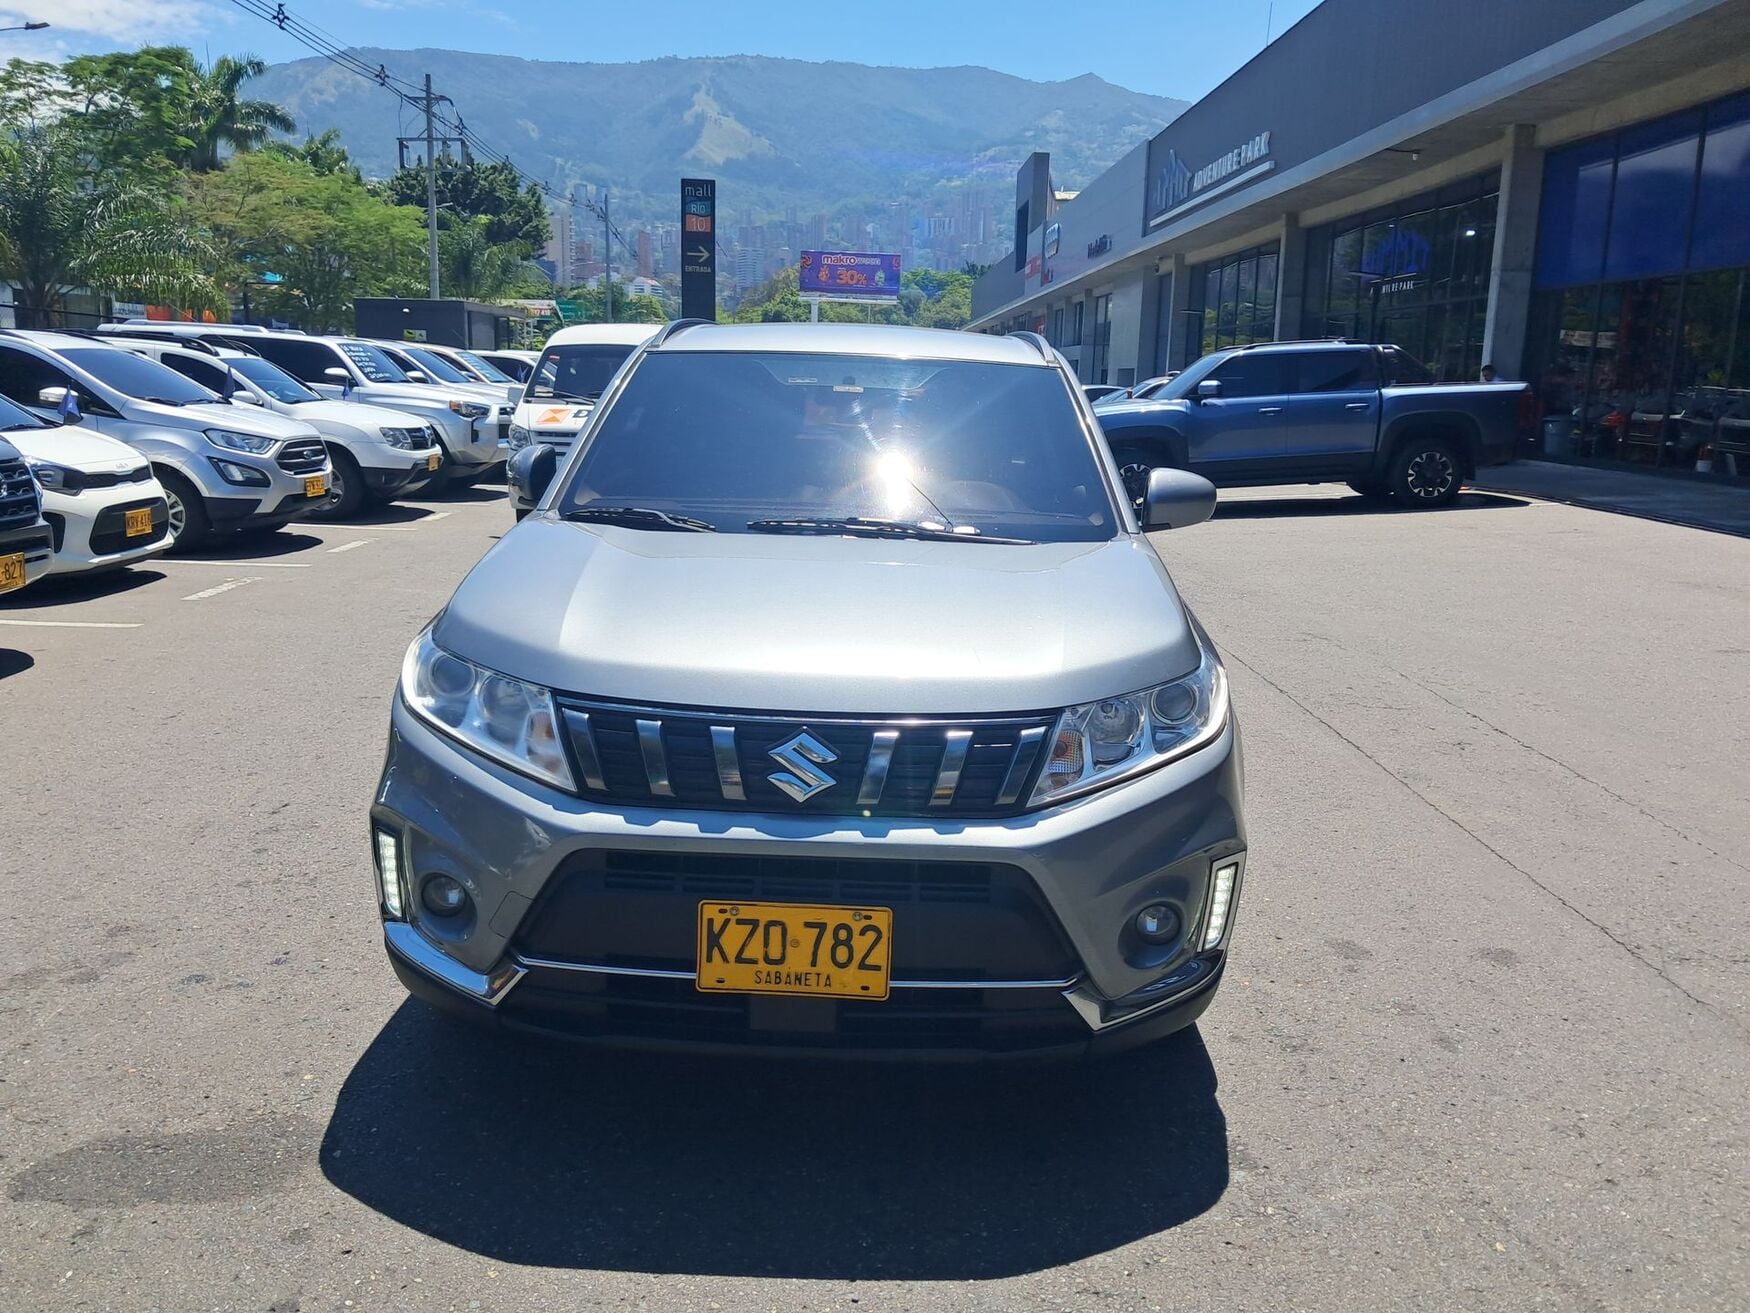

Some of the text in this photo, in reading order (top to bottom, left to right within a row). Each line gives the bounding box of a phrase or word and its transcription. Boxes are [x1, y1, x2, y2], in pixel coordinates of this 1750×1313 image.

[1192, 130, 1271, 193] ADVENTURE PARK
[684, 183, 712, 198] mall
[690, 217, 706, 232] 10
[836, 269, 868, 285] 30%
[4, 559, 23, 581] 827
[705, 917, 884, 973] KZO 782
[754, 969, 833, 989] SABANETA
